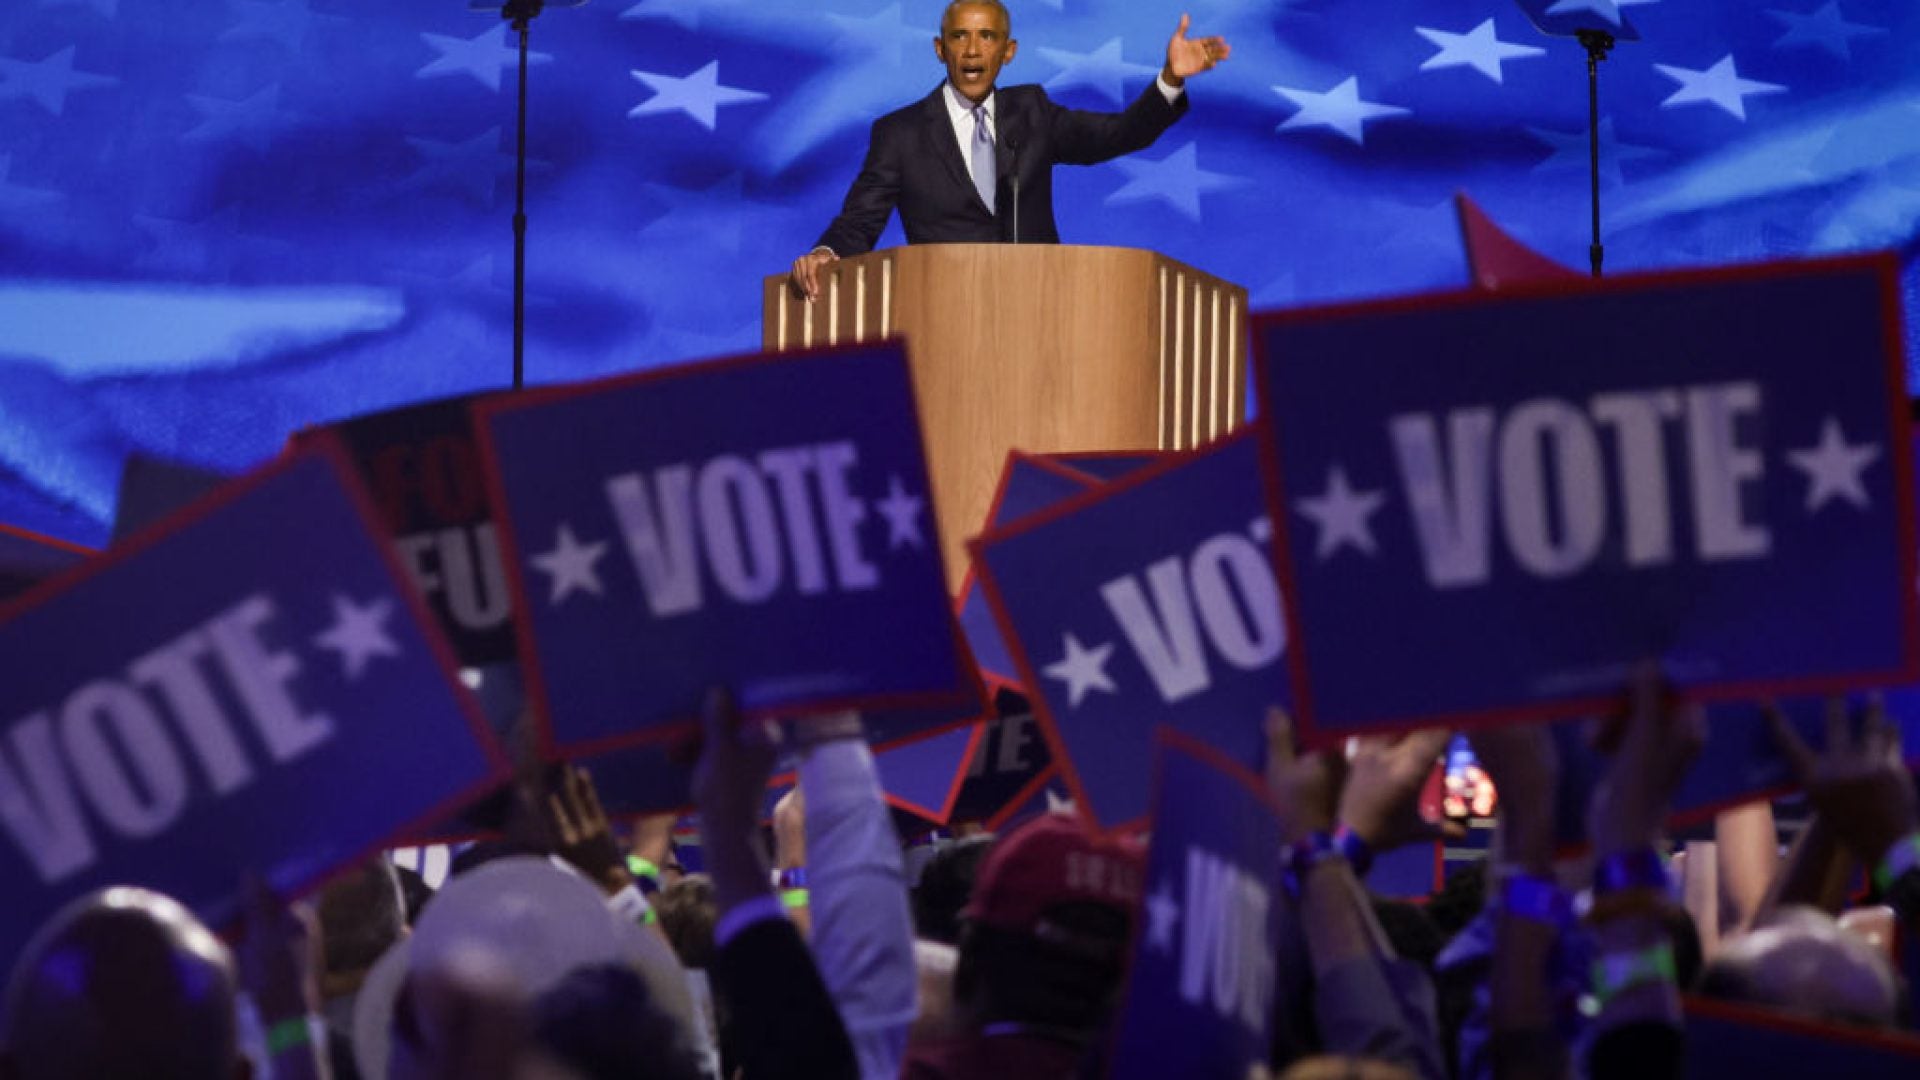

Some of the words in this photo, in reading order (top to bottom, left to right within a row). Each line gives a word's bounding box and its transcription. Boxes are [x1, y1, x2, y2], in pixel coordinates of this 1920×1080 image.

[605, 440, 880, 617] VOTE
[1388, 381, 1772, 588] VOTE
[1100, 516, 1287, 703] VO
[0, 593, 336, 886] VOTE
